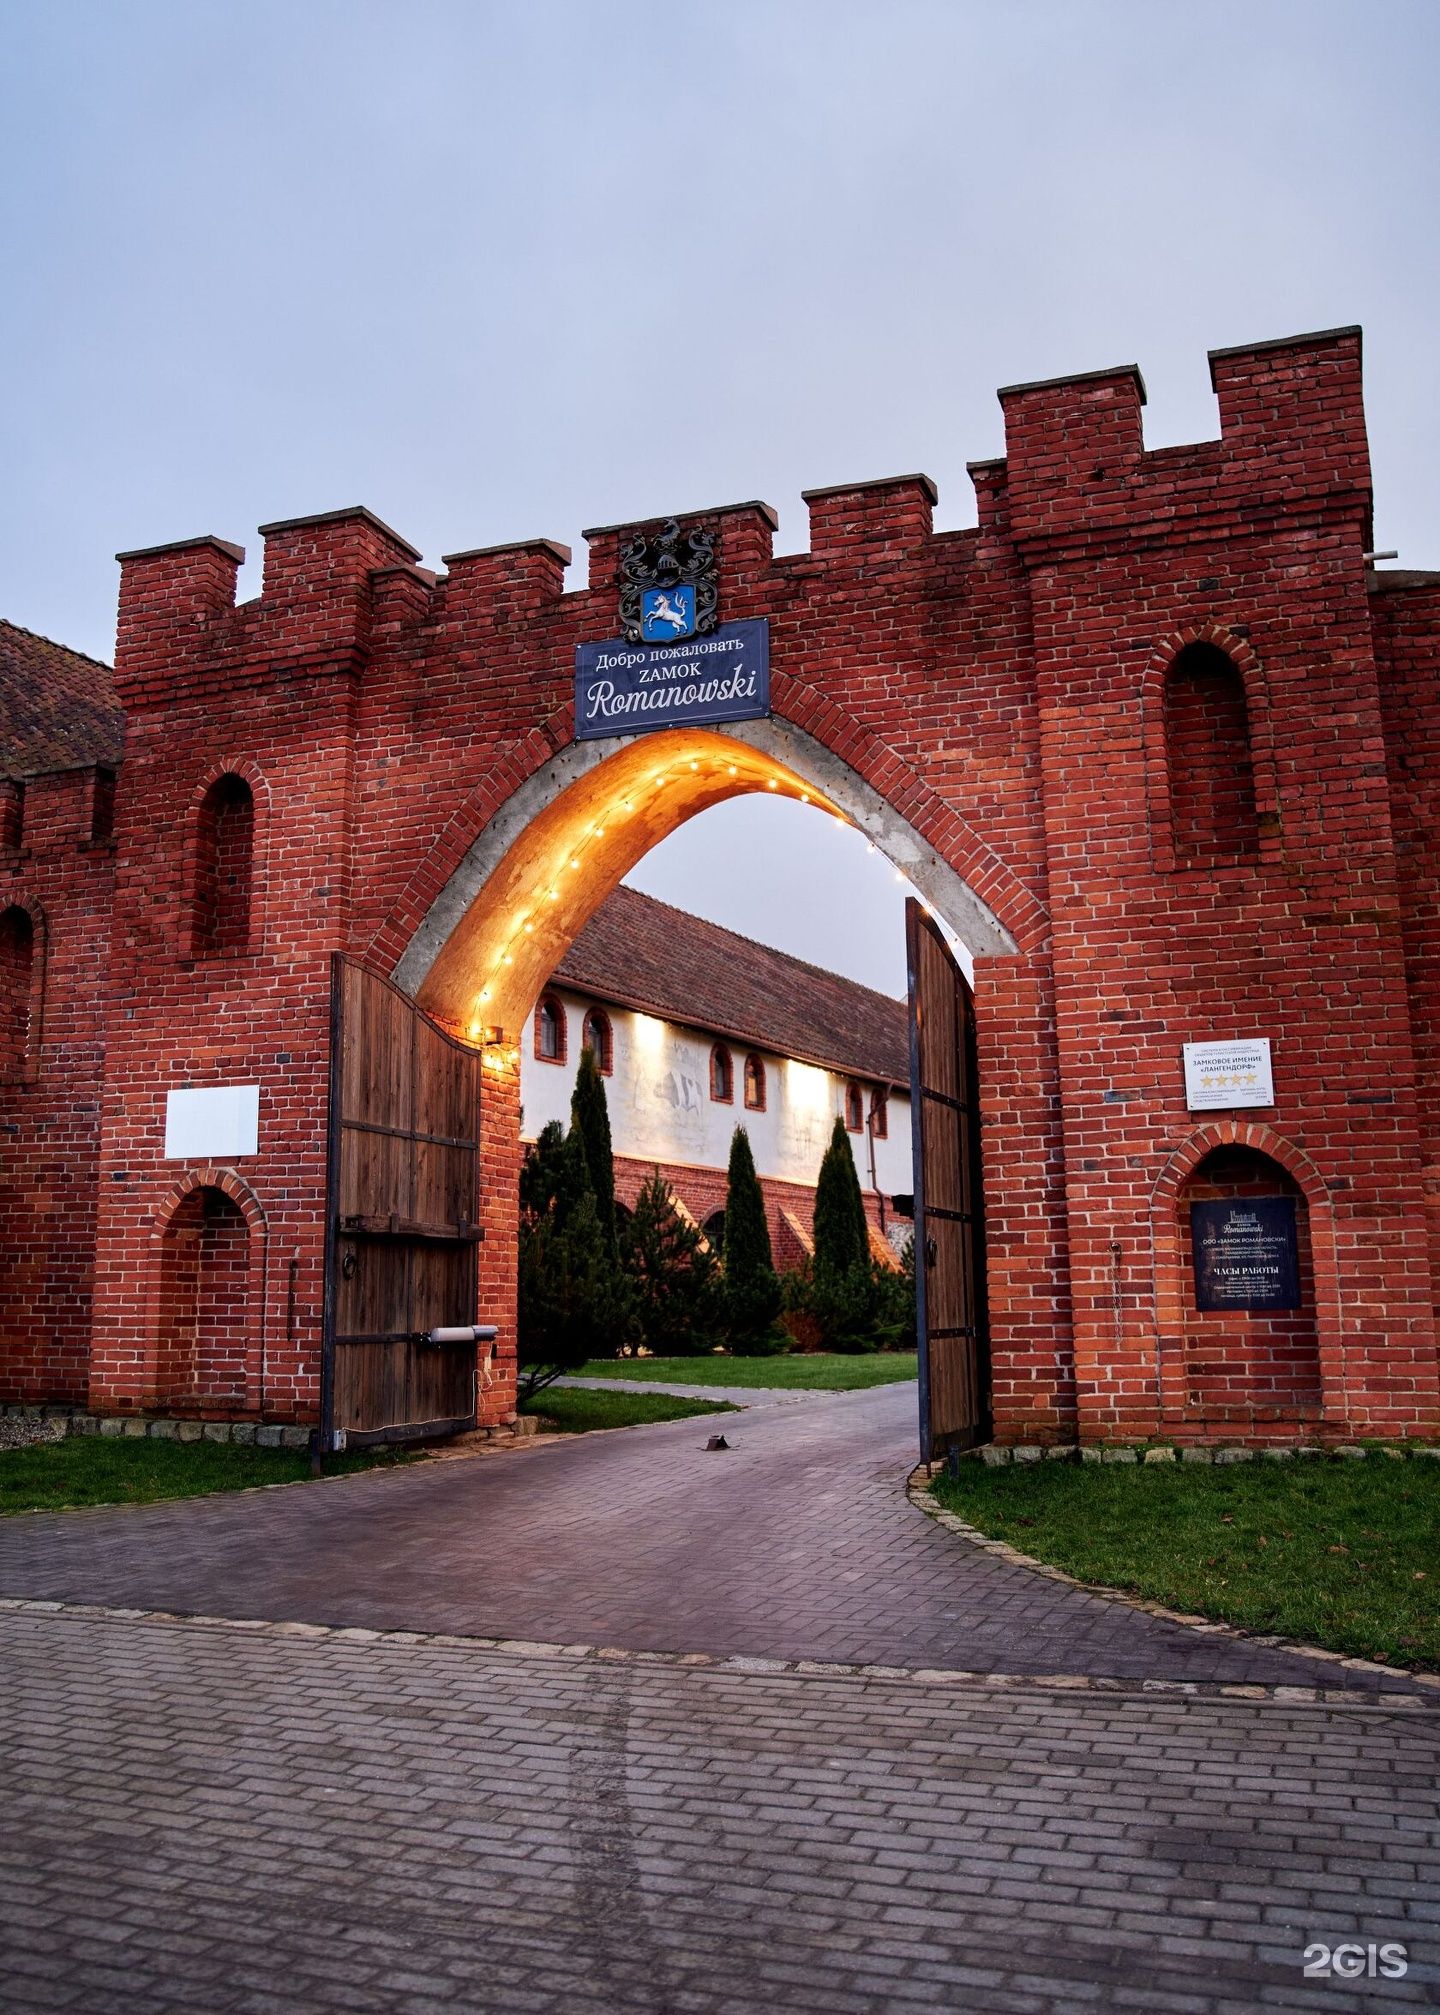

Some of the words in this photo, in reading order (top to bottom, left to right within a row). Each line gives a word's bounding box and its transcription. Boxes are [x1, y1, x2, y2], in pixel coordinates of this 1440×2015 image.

[596, 651, 645, 672] Добро
[650, 638, 744, 662] пожаловать
[639, 662, 701, 683] ZAMOK
[586, 663, 756, 719] Romanowski
[1193, 1057, 1231, 1067] ЗАМКОВОЕ
[1232, 1055, 1262, 1064] ИМЕНИЕ
[1223, 1223, 1263, 1234] Romanowski
[1213, 1267, 1240, 1276] ЧАСЫ
[1242, 1266, 1279, 1275] РАБОТЫ
